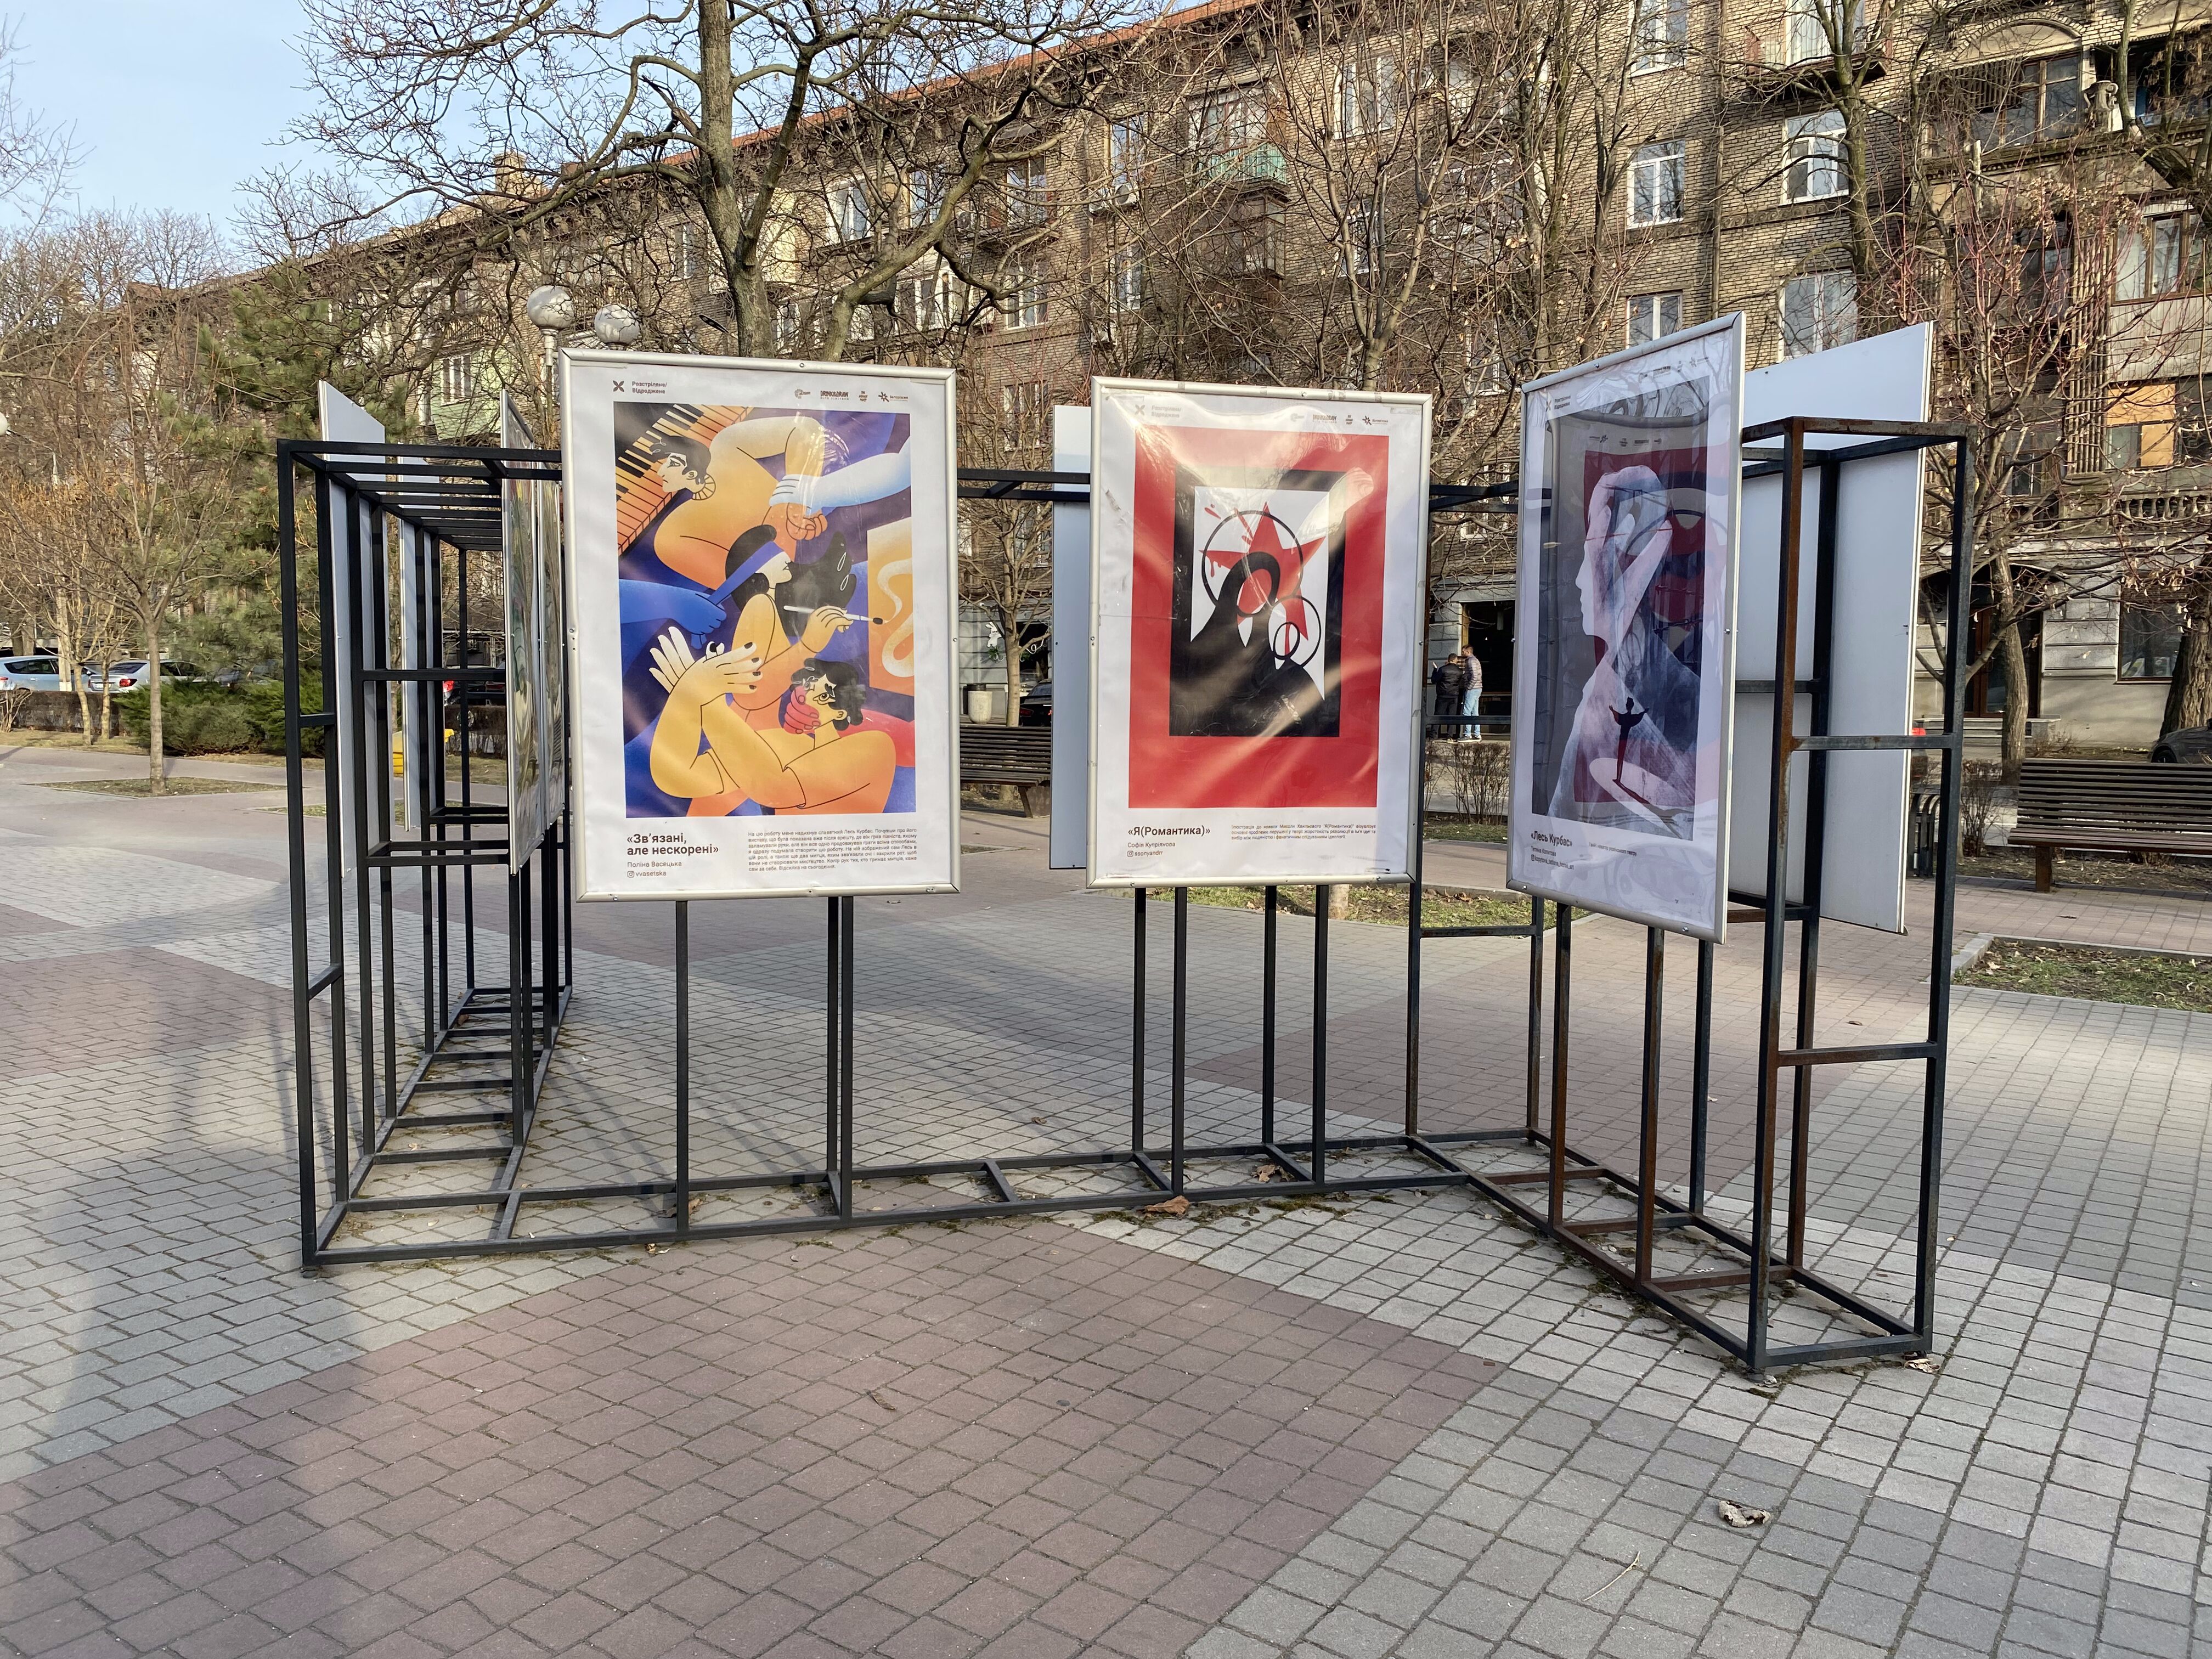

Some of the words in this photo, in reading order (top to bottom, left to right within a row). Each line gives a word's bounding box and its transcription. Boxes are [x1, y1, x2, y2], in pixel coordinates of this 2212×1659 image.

[1128, 825, 1210, 838] «Я(Романтика)»
[1531, 831, 1548, 842] «Лесь
[1549, 834, 1572, 847] Курбас»
[627, 847, 648, 855] але
[652, 844, 719, 856] нескорені»
